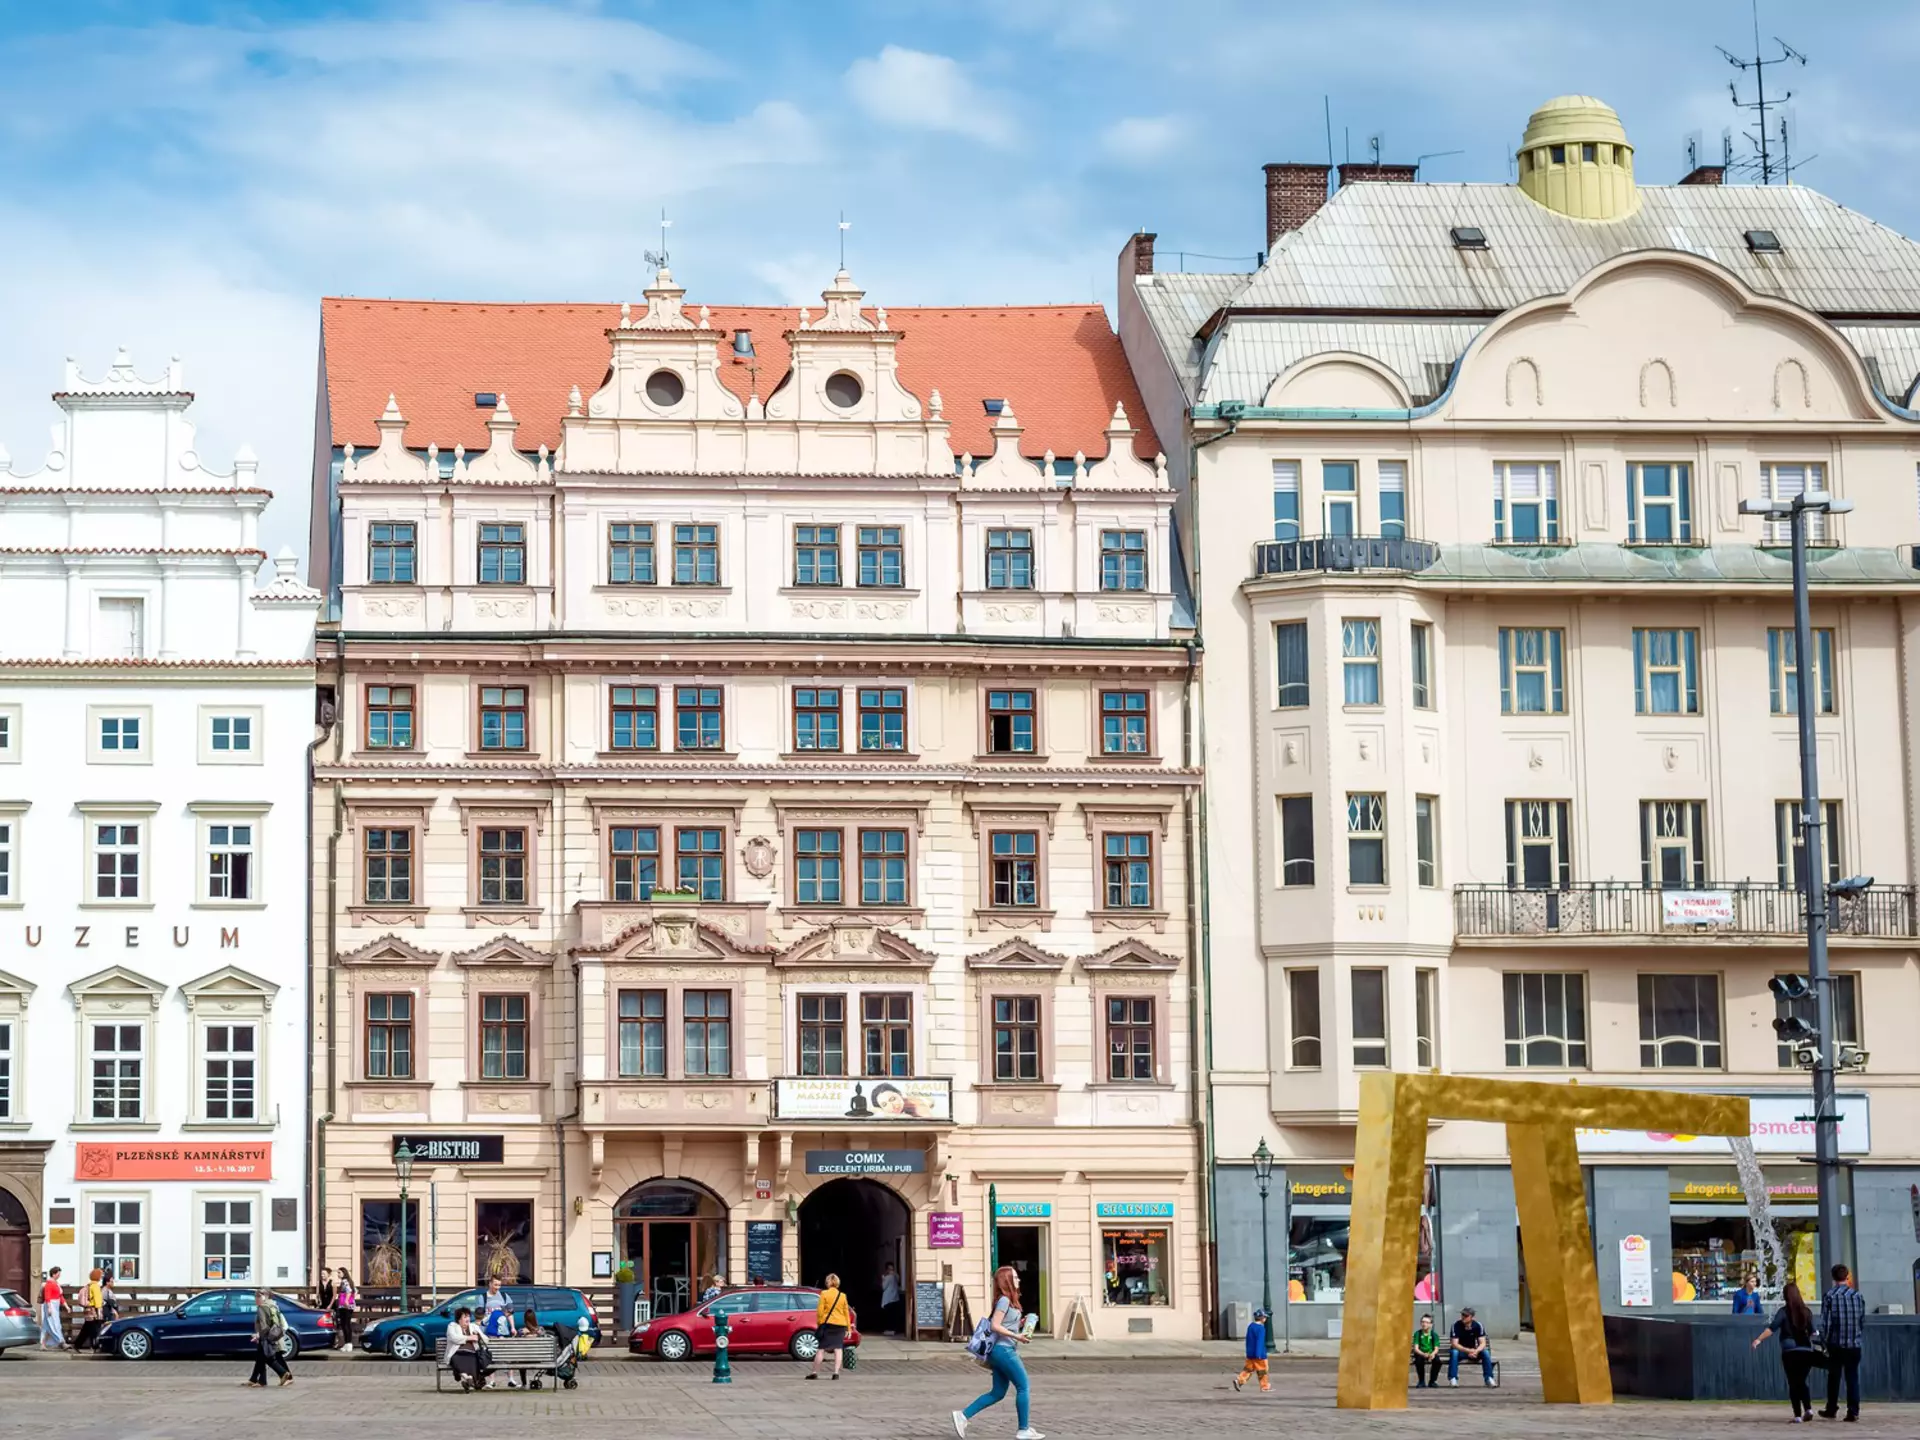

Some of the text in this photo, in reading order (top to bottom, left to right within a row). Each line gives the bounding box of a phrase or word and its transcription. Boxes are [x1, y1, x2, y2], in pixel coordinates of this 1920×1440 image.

[428, 1140, 480, 1156] BISTRO
[116, 1149, 265, 1161] PLZEŇSKÉ KAMNÁŘSTVÍ
[845, 1153, 885, 1164] COMIX
[818, 1165, 912, 1173] EXCELENT URBAN PUB
[1291, 1182, 1346, 1197] drogerie
[1684, 1182, 1738, 1197] drogerie
[1001, 1204, 1044, 1214] OVOCE
[1102, 1204, 1169, 1214] ZELENINA
